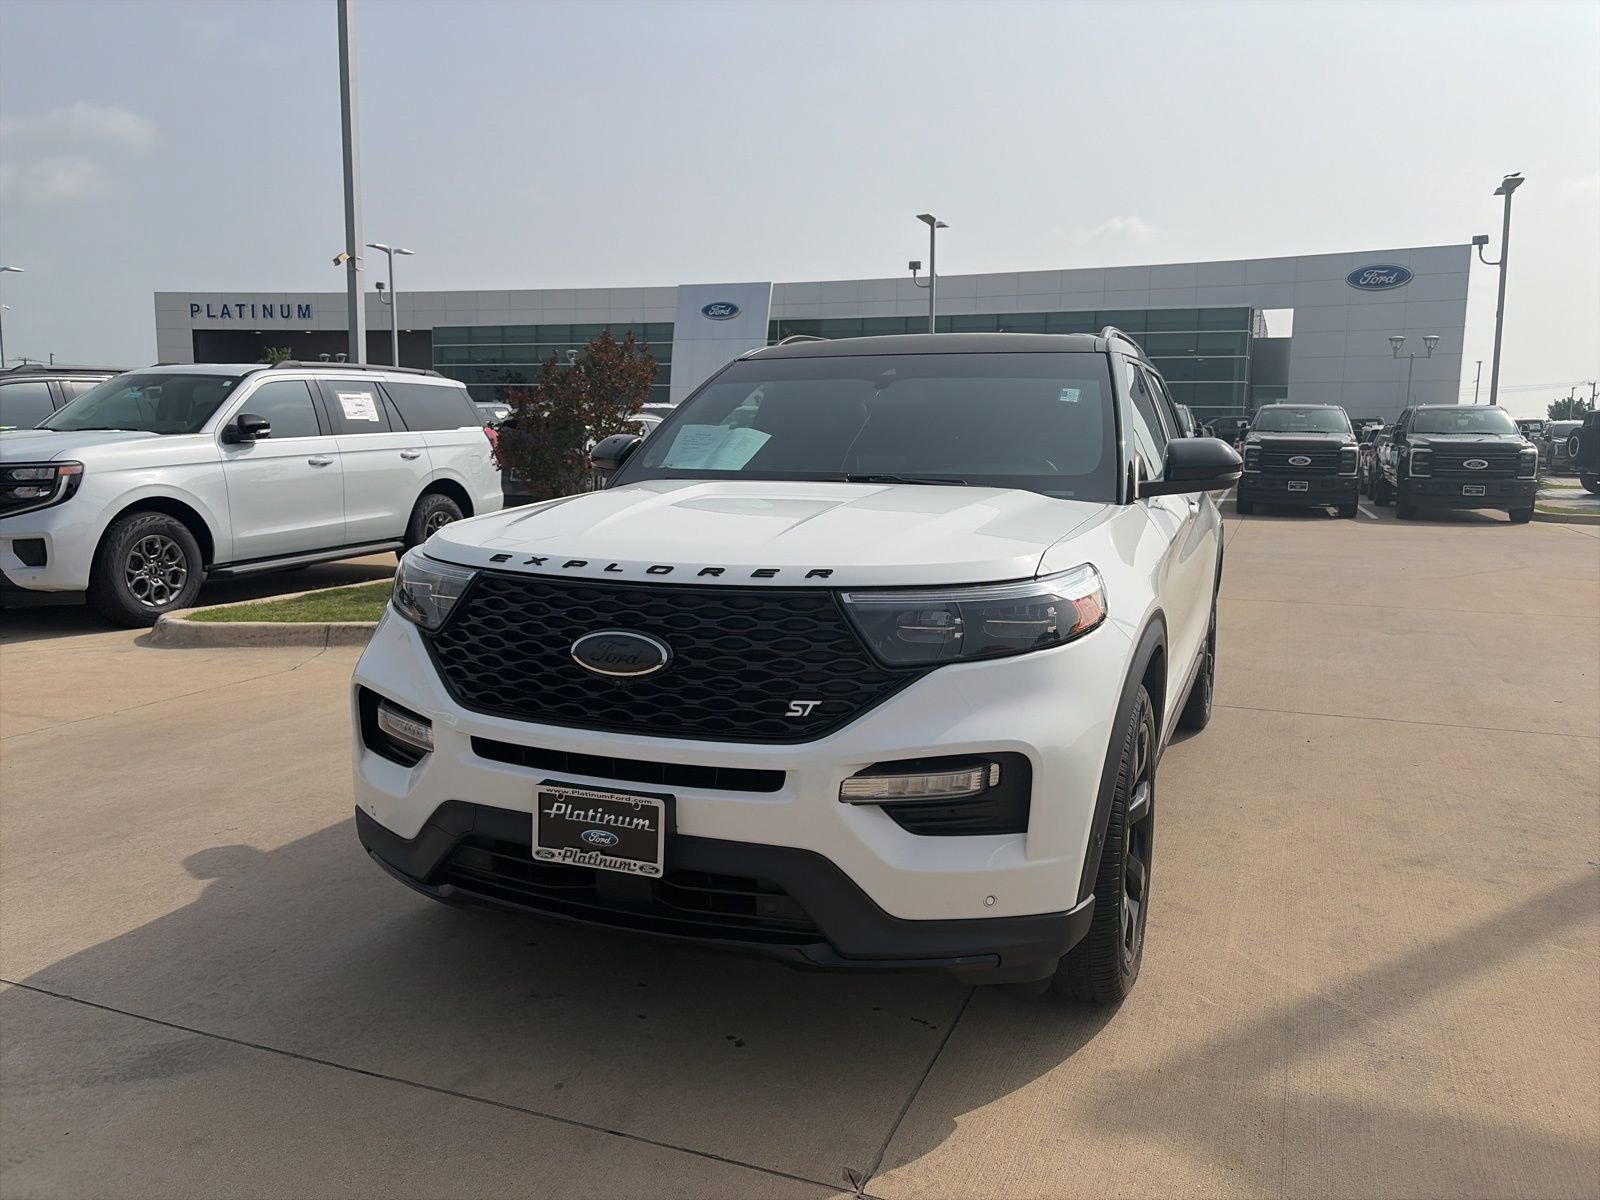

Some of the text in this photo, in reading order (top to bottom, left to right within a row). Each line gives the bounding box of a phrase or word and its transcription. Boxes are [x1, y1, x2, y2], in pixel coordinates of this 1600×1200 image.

[1359, 269, 1399, 284] Ford
[190, 303, 311, 319] PLATINUM
[708, 304, 732, 315] Ford
[488, 552, 834, 579] EXPLORER
[590, 640, 642, 665] Ford
[784, 700, 823, 717] ST
[545, 787, 653, 805] www.PlatinumFord.com
[543, 802, 656, 832] Platinum
[588, 832, 612, 845] Ford
[561, 849, 637, 872] Platinum
